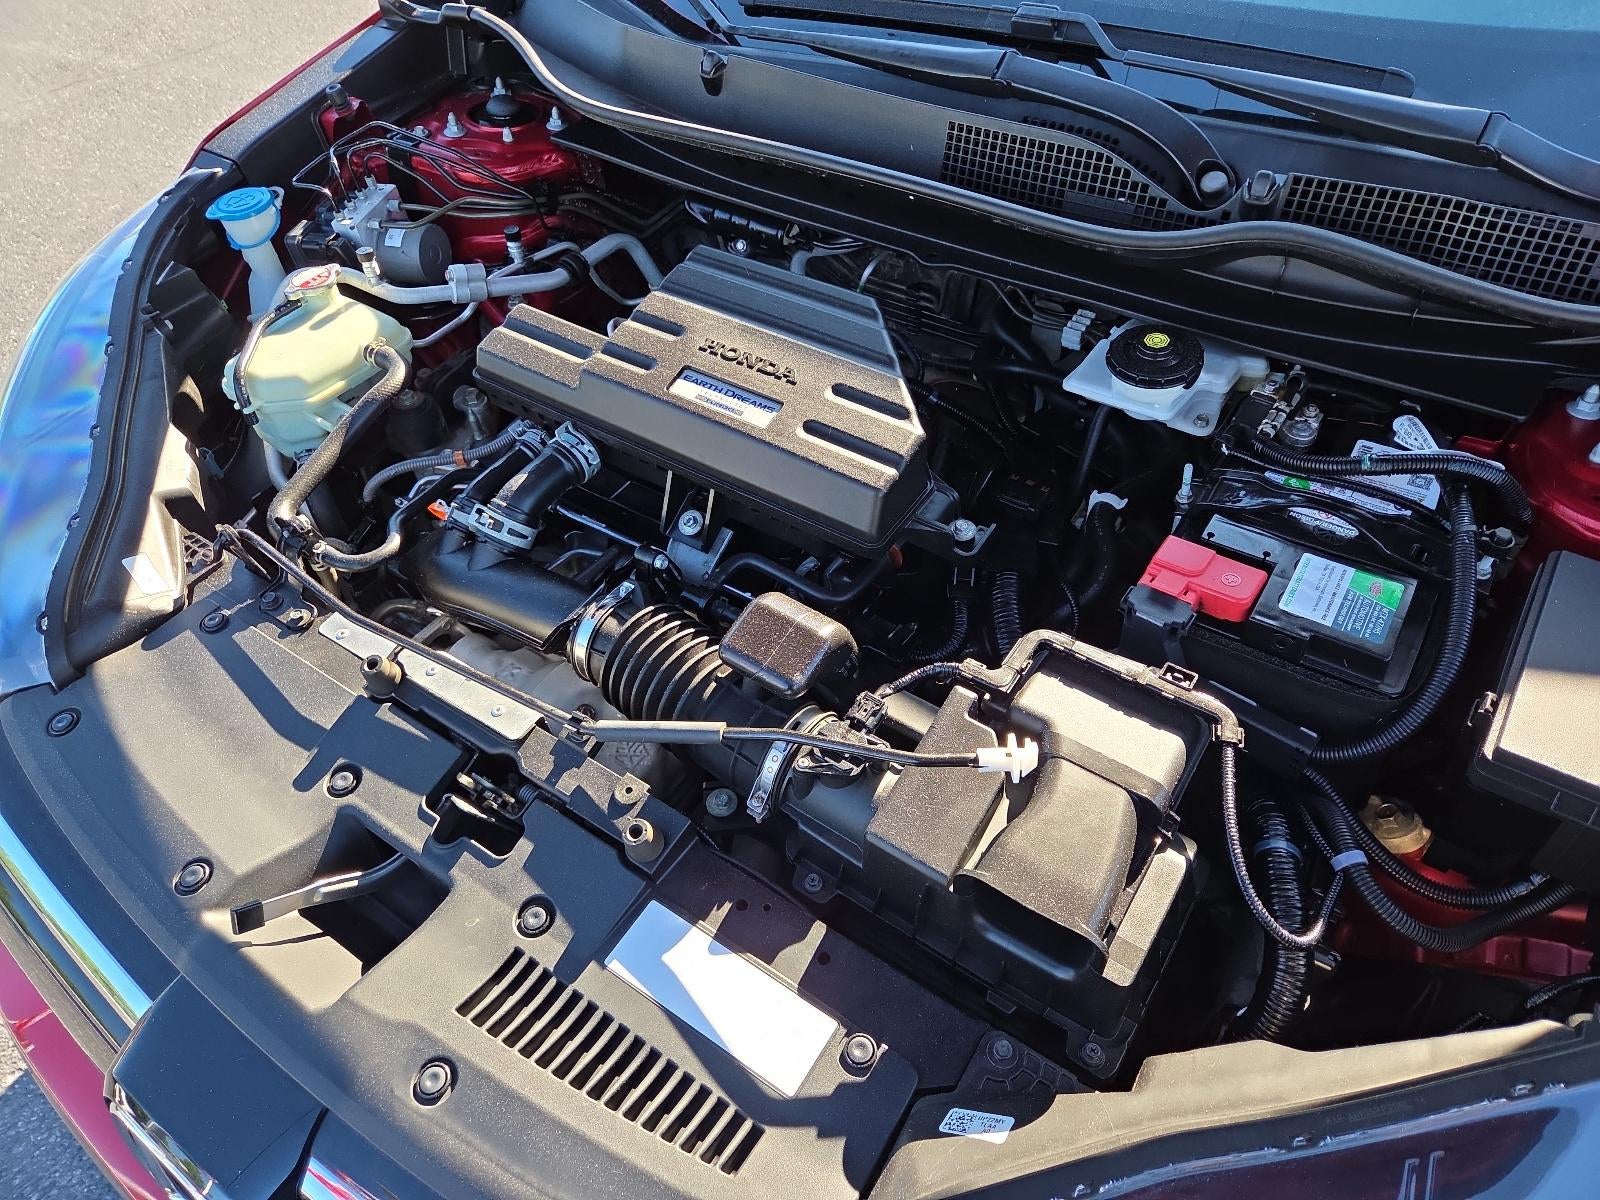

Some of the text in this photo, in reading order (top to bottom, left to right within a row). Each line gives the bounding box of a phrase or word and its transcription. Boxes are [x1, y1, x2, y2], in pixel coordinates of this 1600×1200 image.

[698, 338, 797, 386] HONDA
[683, 374, 724, 395] EARTH
[724, 389, 776, 414] DREAMS
[1288, 511, 1356, 536] DANGER/POISON
[1352, 598, 1370, 630] AUTOMOTIVE
